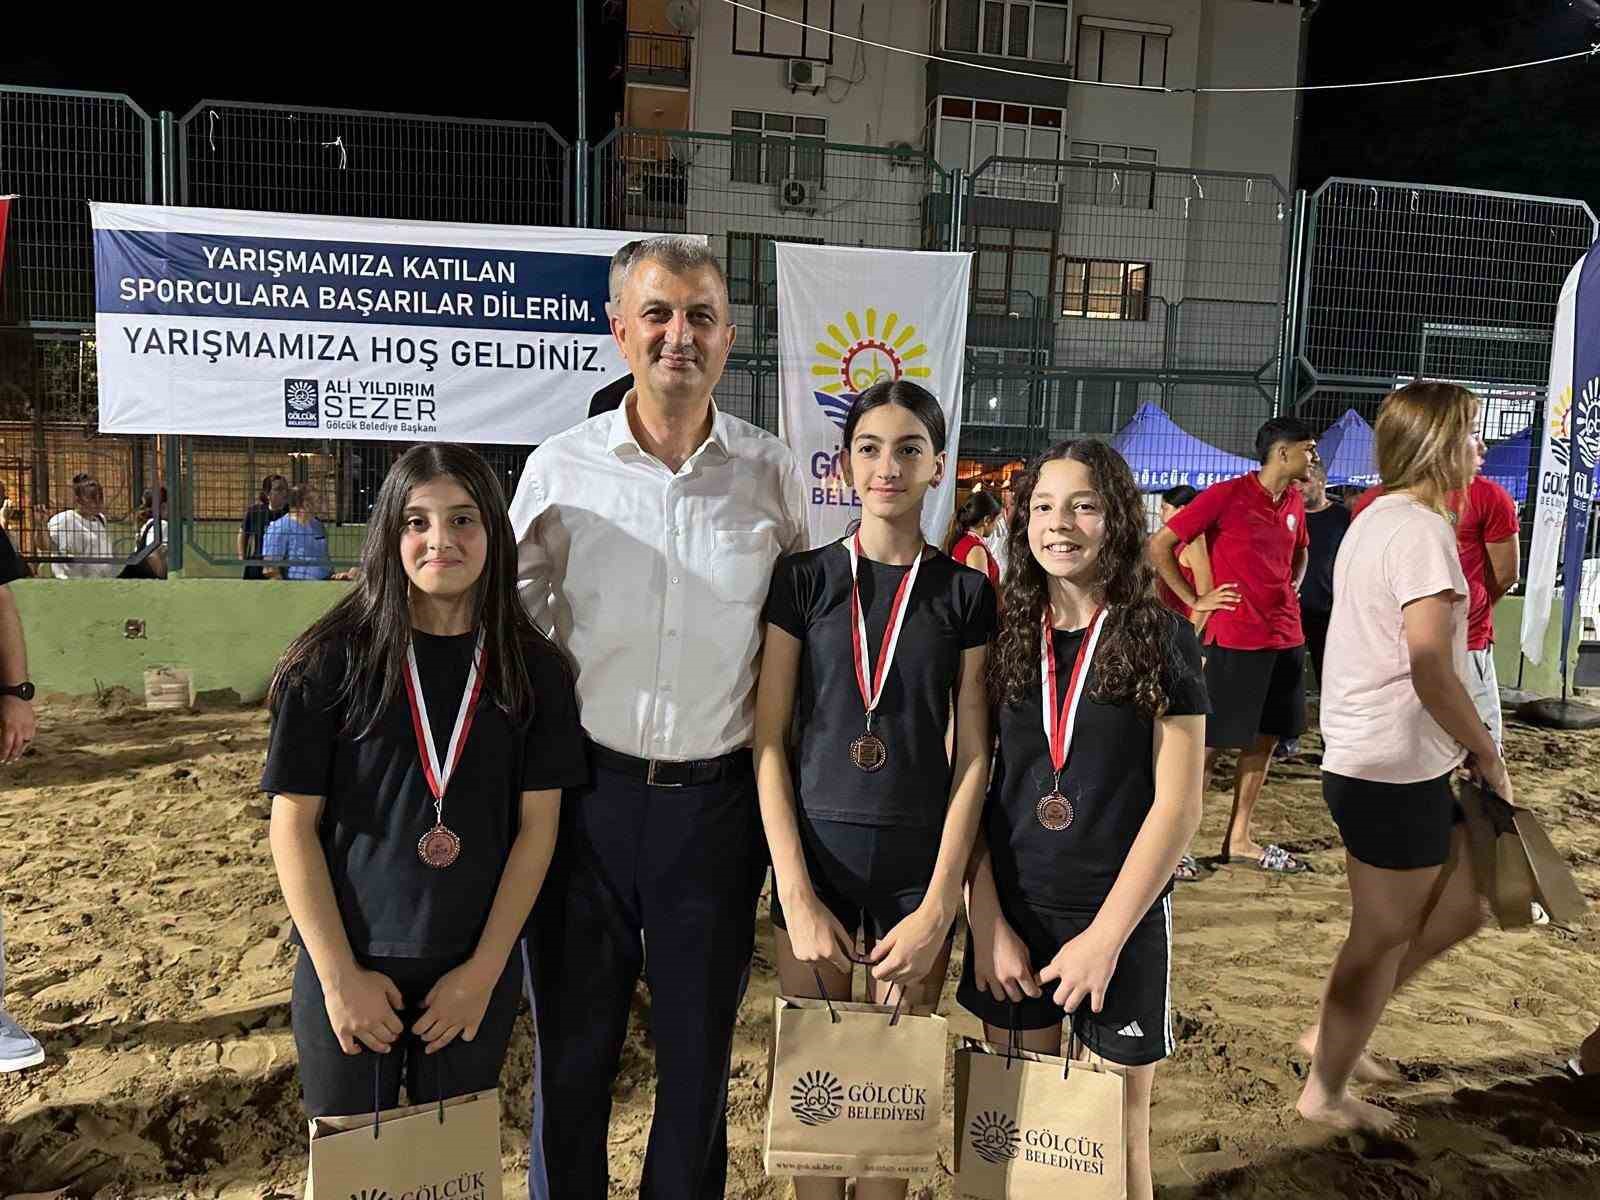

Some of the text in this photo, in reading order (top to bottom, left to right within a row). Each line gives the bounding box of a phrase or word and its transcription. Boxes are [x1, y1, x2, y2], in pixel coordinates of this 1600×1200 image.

[202, 246, 516, 284] YARIŞMAMIZA KATILAN
[119, 278, 596, 322] SPORCULARA BAŞARILAR DİLERİM.
[123, 326, 606, 372] YARIŞMAMIZA HOŞ GELDİNİZ.
[325, 379, 434, 397] ALİ YILDIRIM
[324, 395, 436, 421] SEZER
[326, 420, 437, 434] Gölcük Belediye Başkanı
[848, 1082, 927, 1105] GÖLCÜK
[848, 1105, 926, 1121] BELEDİYESİ
[1025, 1129, 1105, 1159] GÖLCÜK
[1025, 1149, 1104, 1176] BELEDİYESİ
